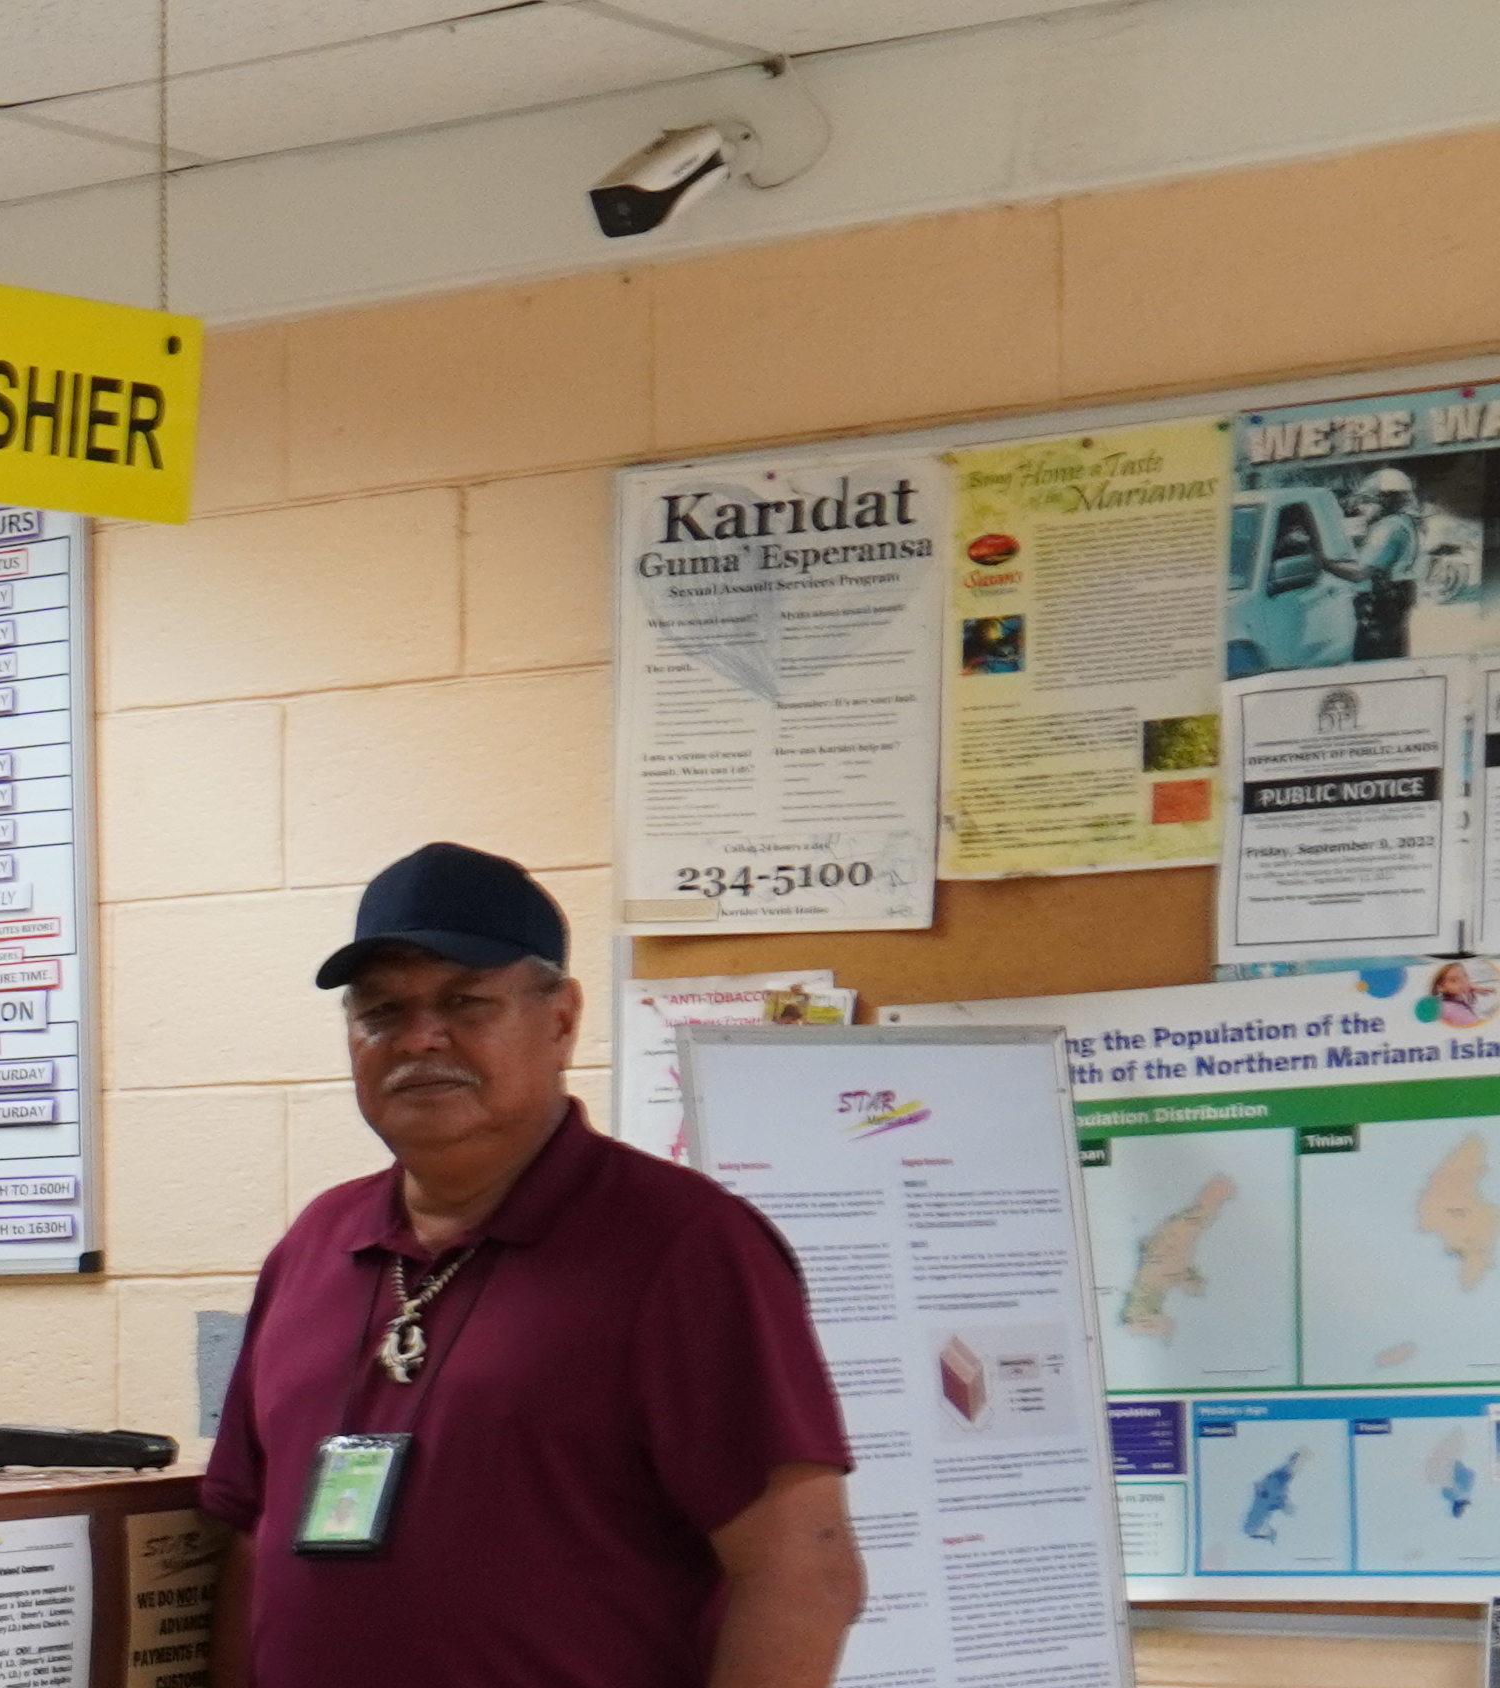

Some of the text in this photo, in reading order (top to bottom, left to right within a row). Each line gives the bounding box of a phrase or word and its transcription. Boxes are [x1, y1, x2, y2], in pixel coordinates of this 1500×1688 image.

[657, 475, 920, 544] Karidat
[758, 537, 934, 575] Esperansa
[668, 583, 717, 598] Sexual
[839, 572, 900, 590] Program
[1259, 776, 1425, 806] PUBLIC NOTICE
[675, 860, 874, 899] 234-5100
[1103, 1012, 1385, 1051] the Population of the
[1111, 1037, 1500, 1082] of the Northern Mariana Isla
[1153, 1101, 1269, 1122] Distribution
[1306, 1132, 1355, 1148] Tinian
[11, 1183, 29, 1196] TO
[31, 1181, 70, 1196] 1600H
[12, 1222, 26, 1234] to
[29, 1220, 67, 1235] 1630H
